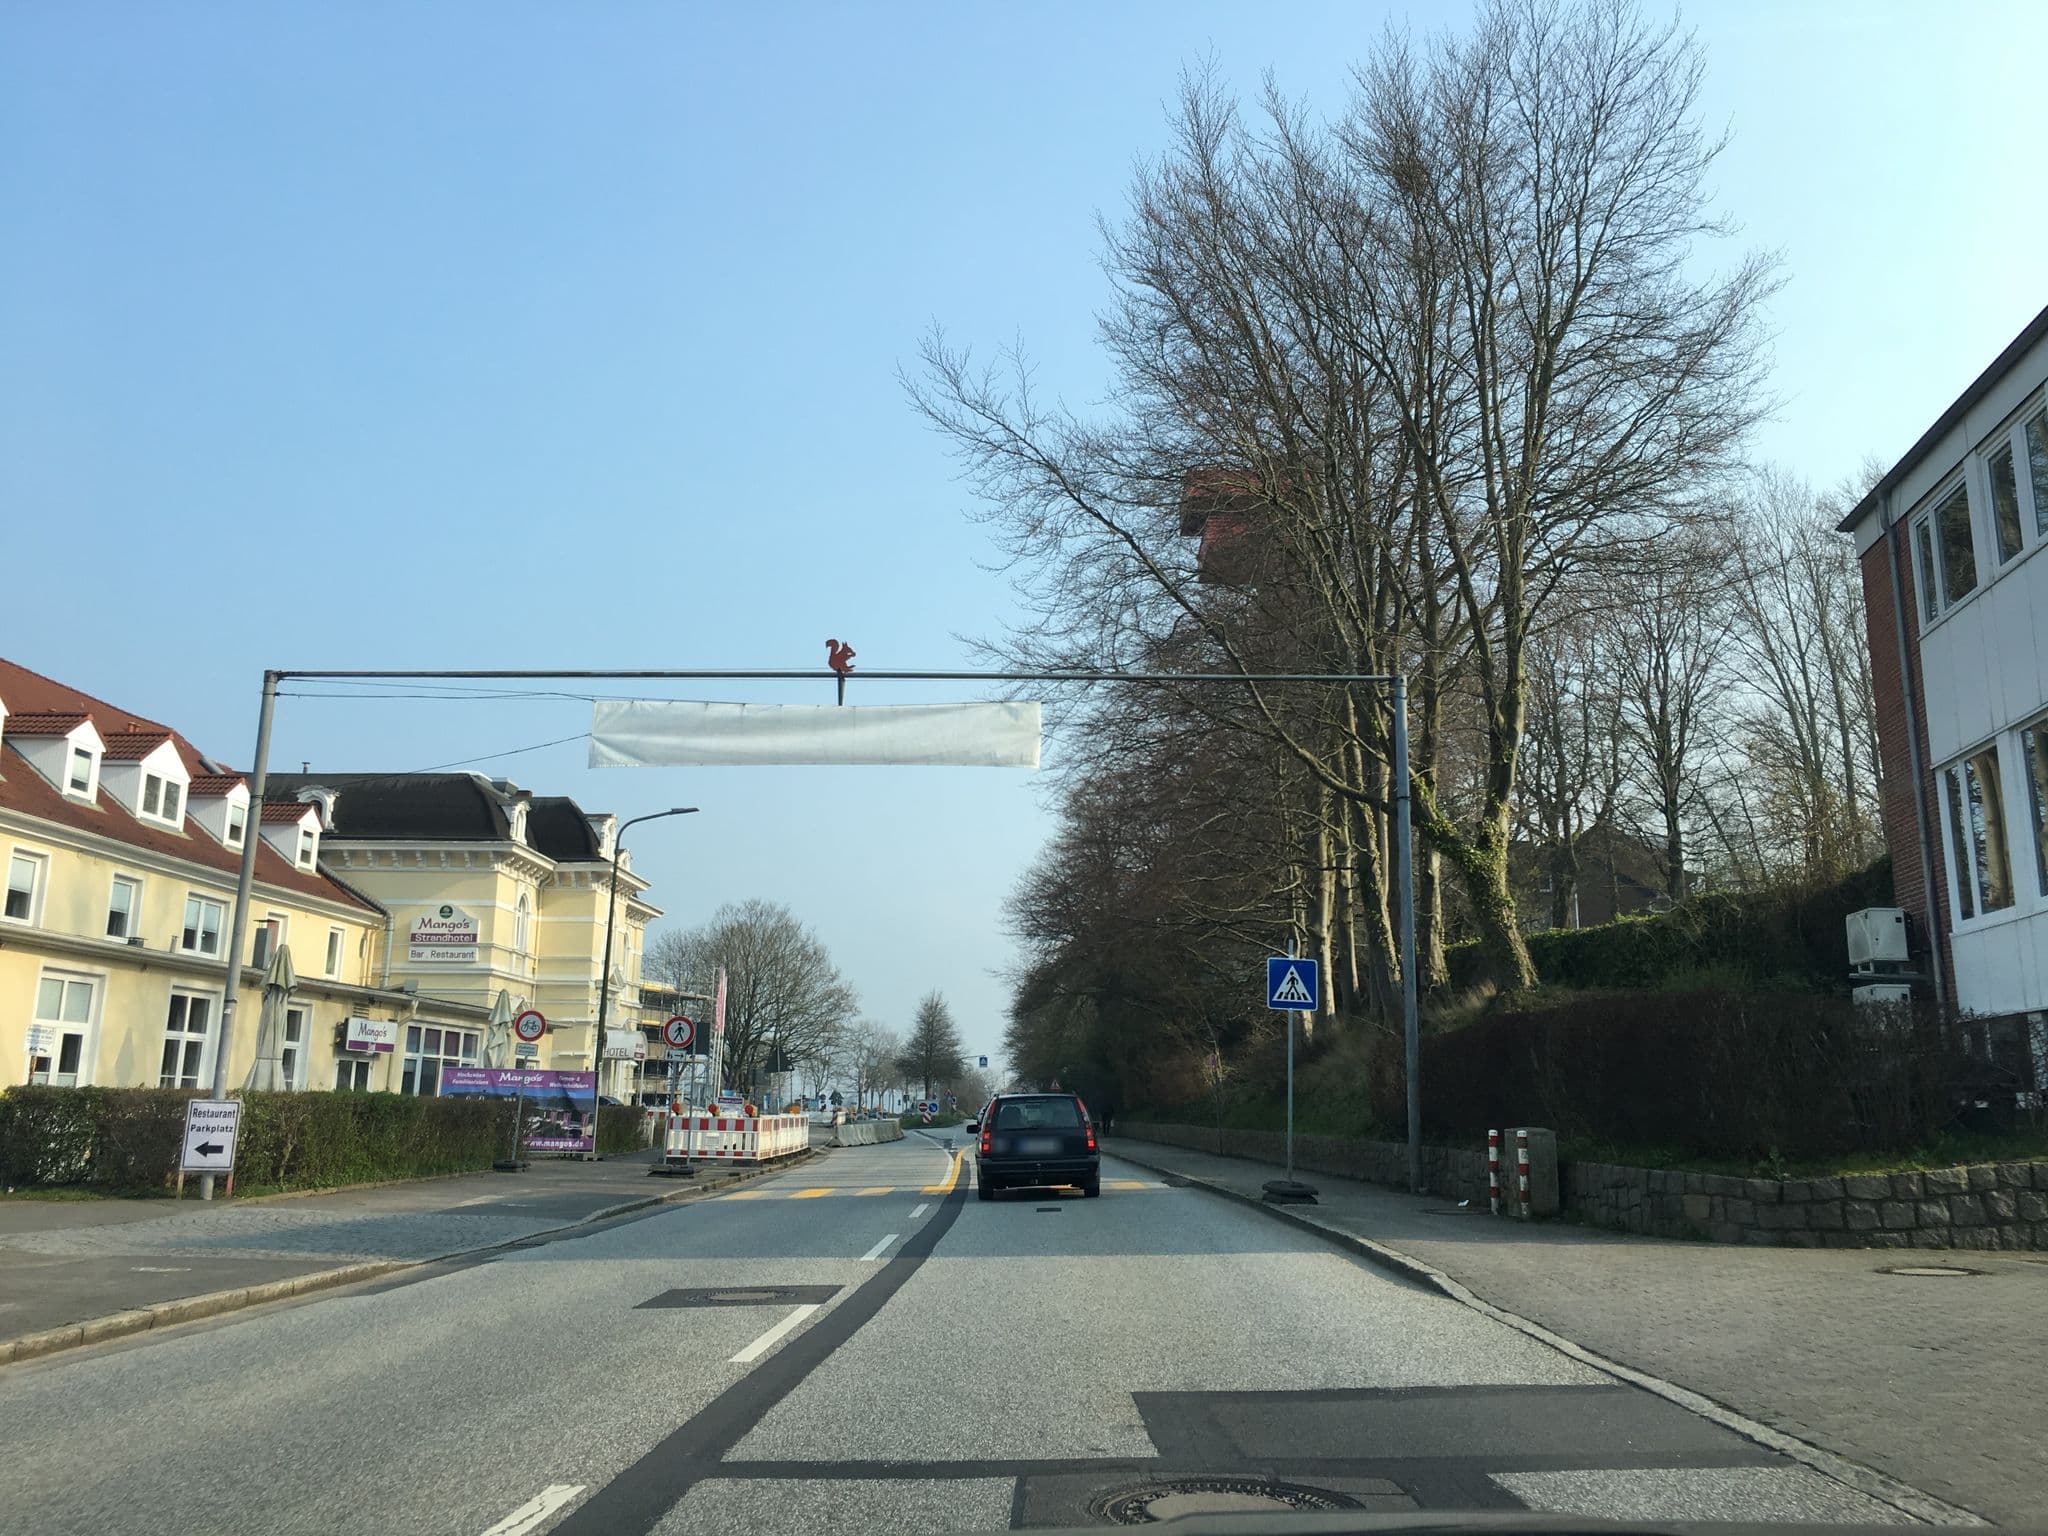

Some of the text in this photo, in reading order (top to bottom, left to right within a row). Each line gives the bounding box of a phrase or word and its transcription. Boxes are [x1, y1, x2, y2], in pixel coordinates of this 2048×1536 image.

[418, 917, 470, 932] Mango's
[415, 933, 473, 943] Strandhotel
[410, 950, 475, 959] Bar Restaurant
[358, 1022, 387, 1041] Mango's
[603, 1047, 630, 1057] HOTEL
[192, 1108, 236, 1118] Restaurant
[190, 1124, 234, 1134] Parkplatz
